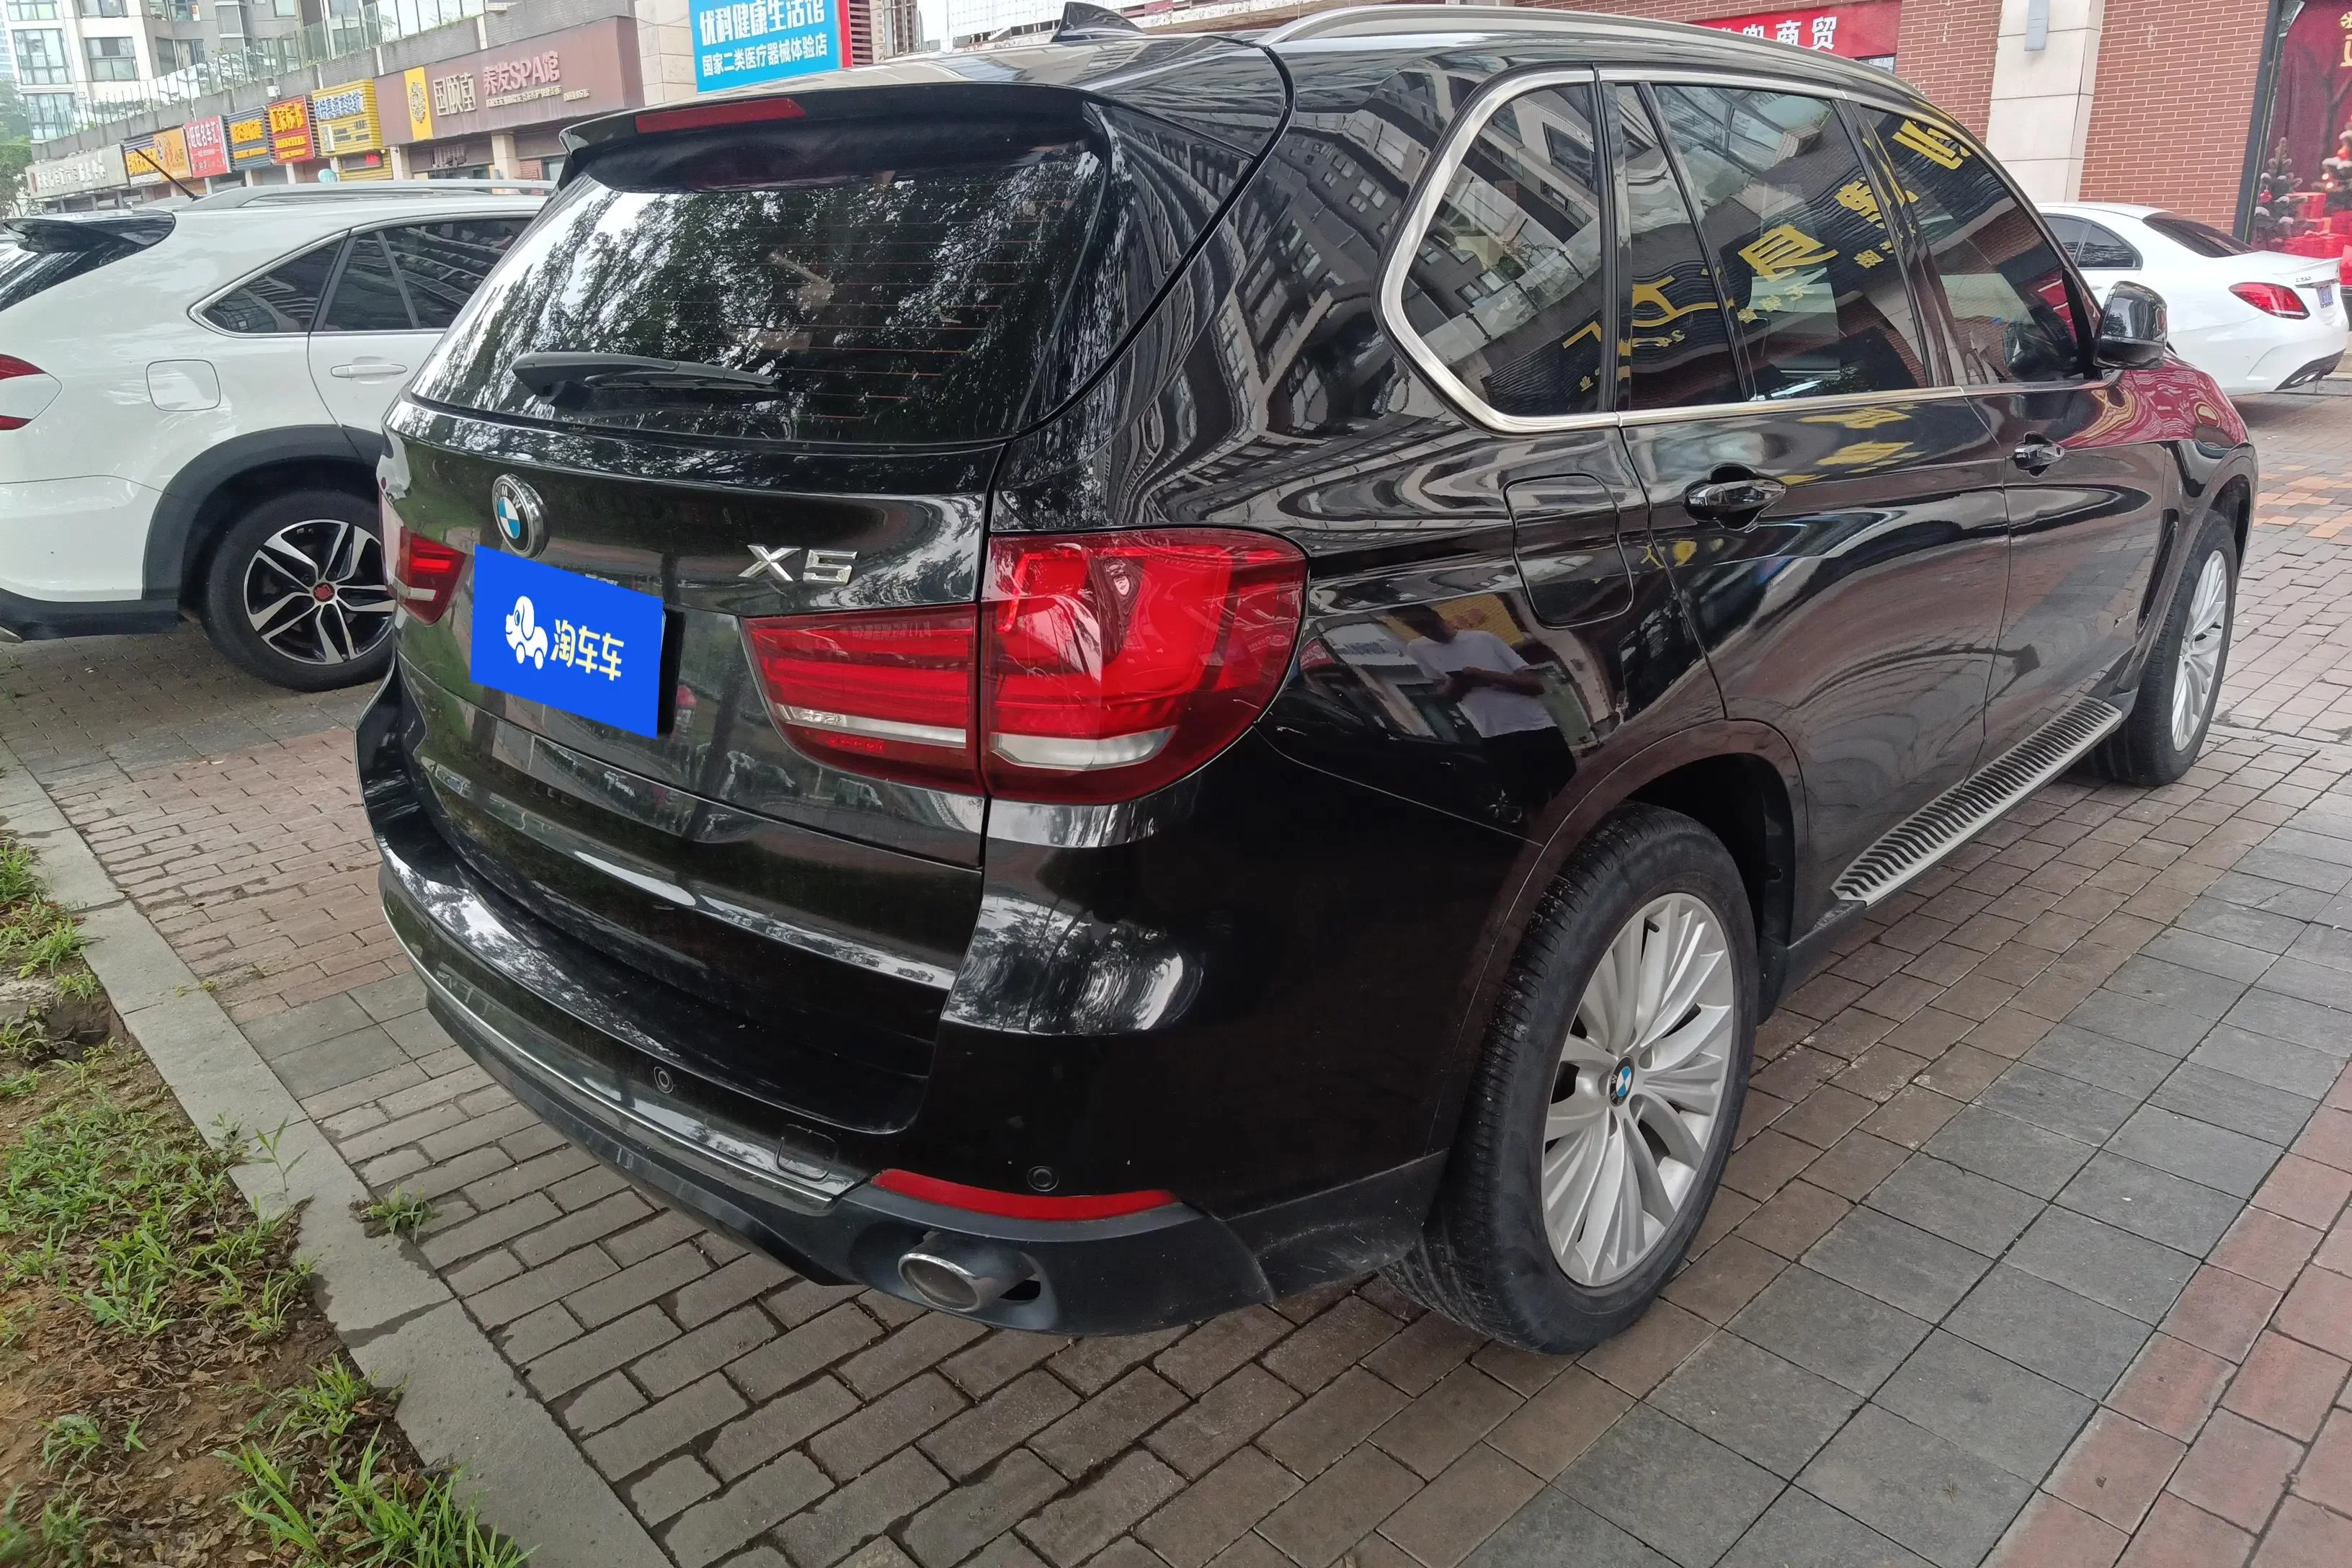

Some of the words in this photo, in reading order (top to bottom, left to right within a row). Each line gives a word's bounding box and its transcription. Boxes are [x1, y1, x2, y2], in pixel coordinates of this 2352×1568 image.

[700, 0, 825, 46] 优科健康生活馆
[702, 32, 828, 77] 国家二类医疗器械体验店
[738, 544, 859, 585] X5
